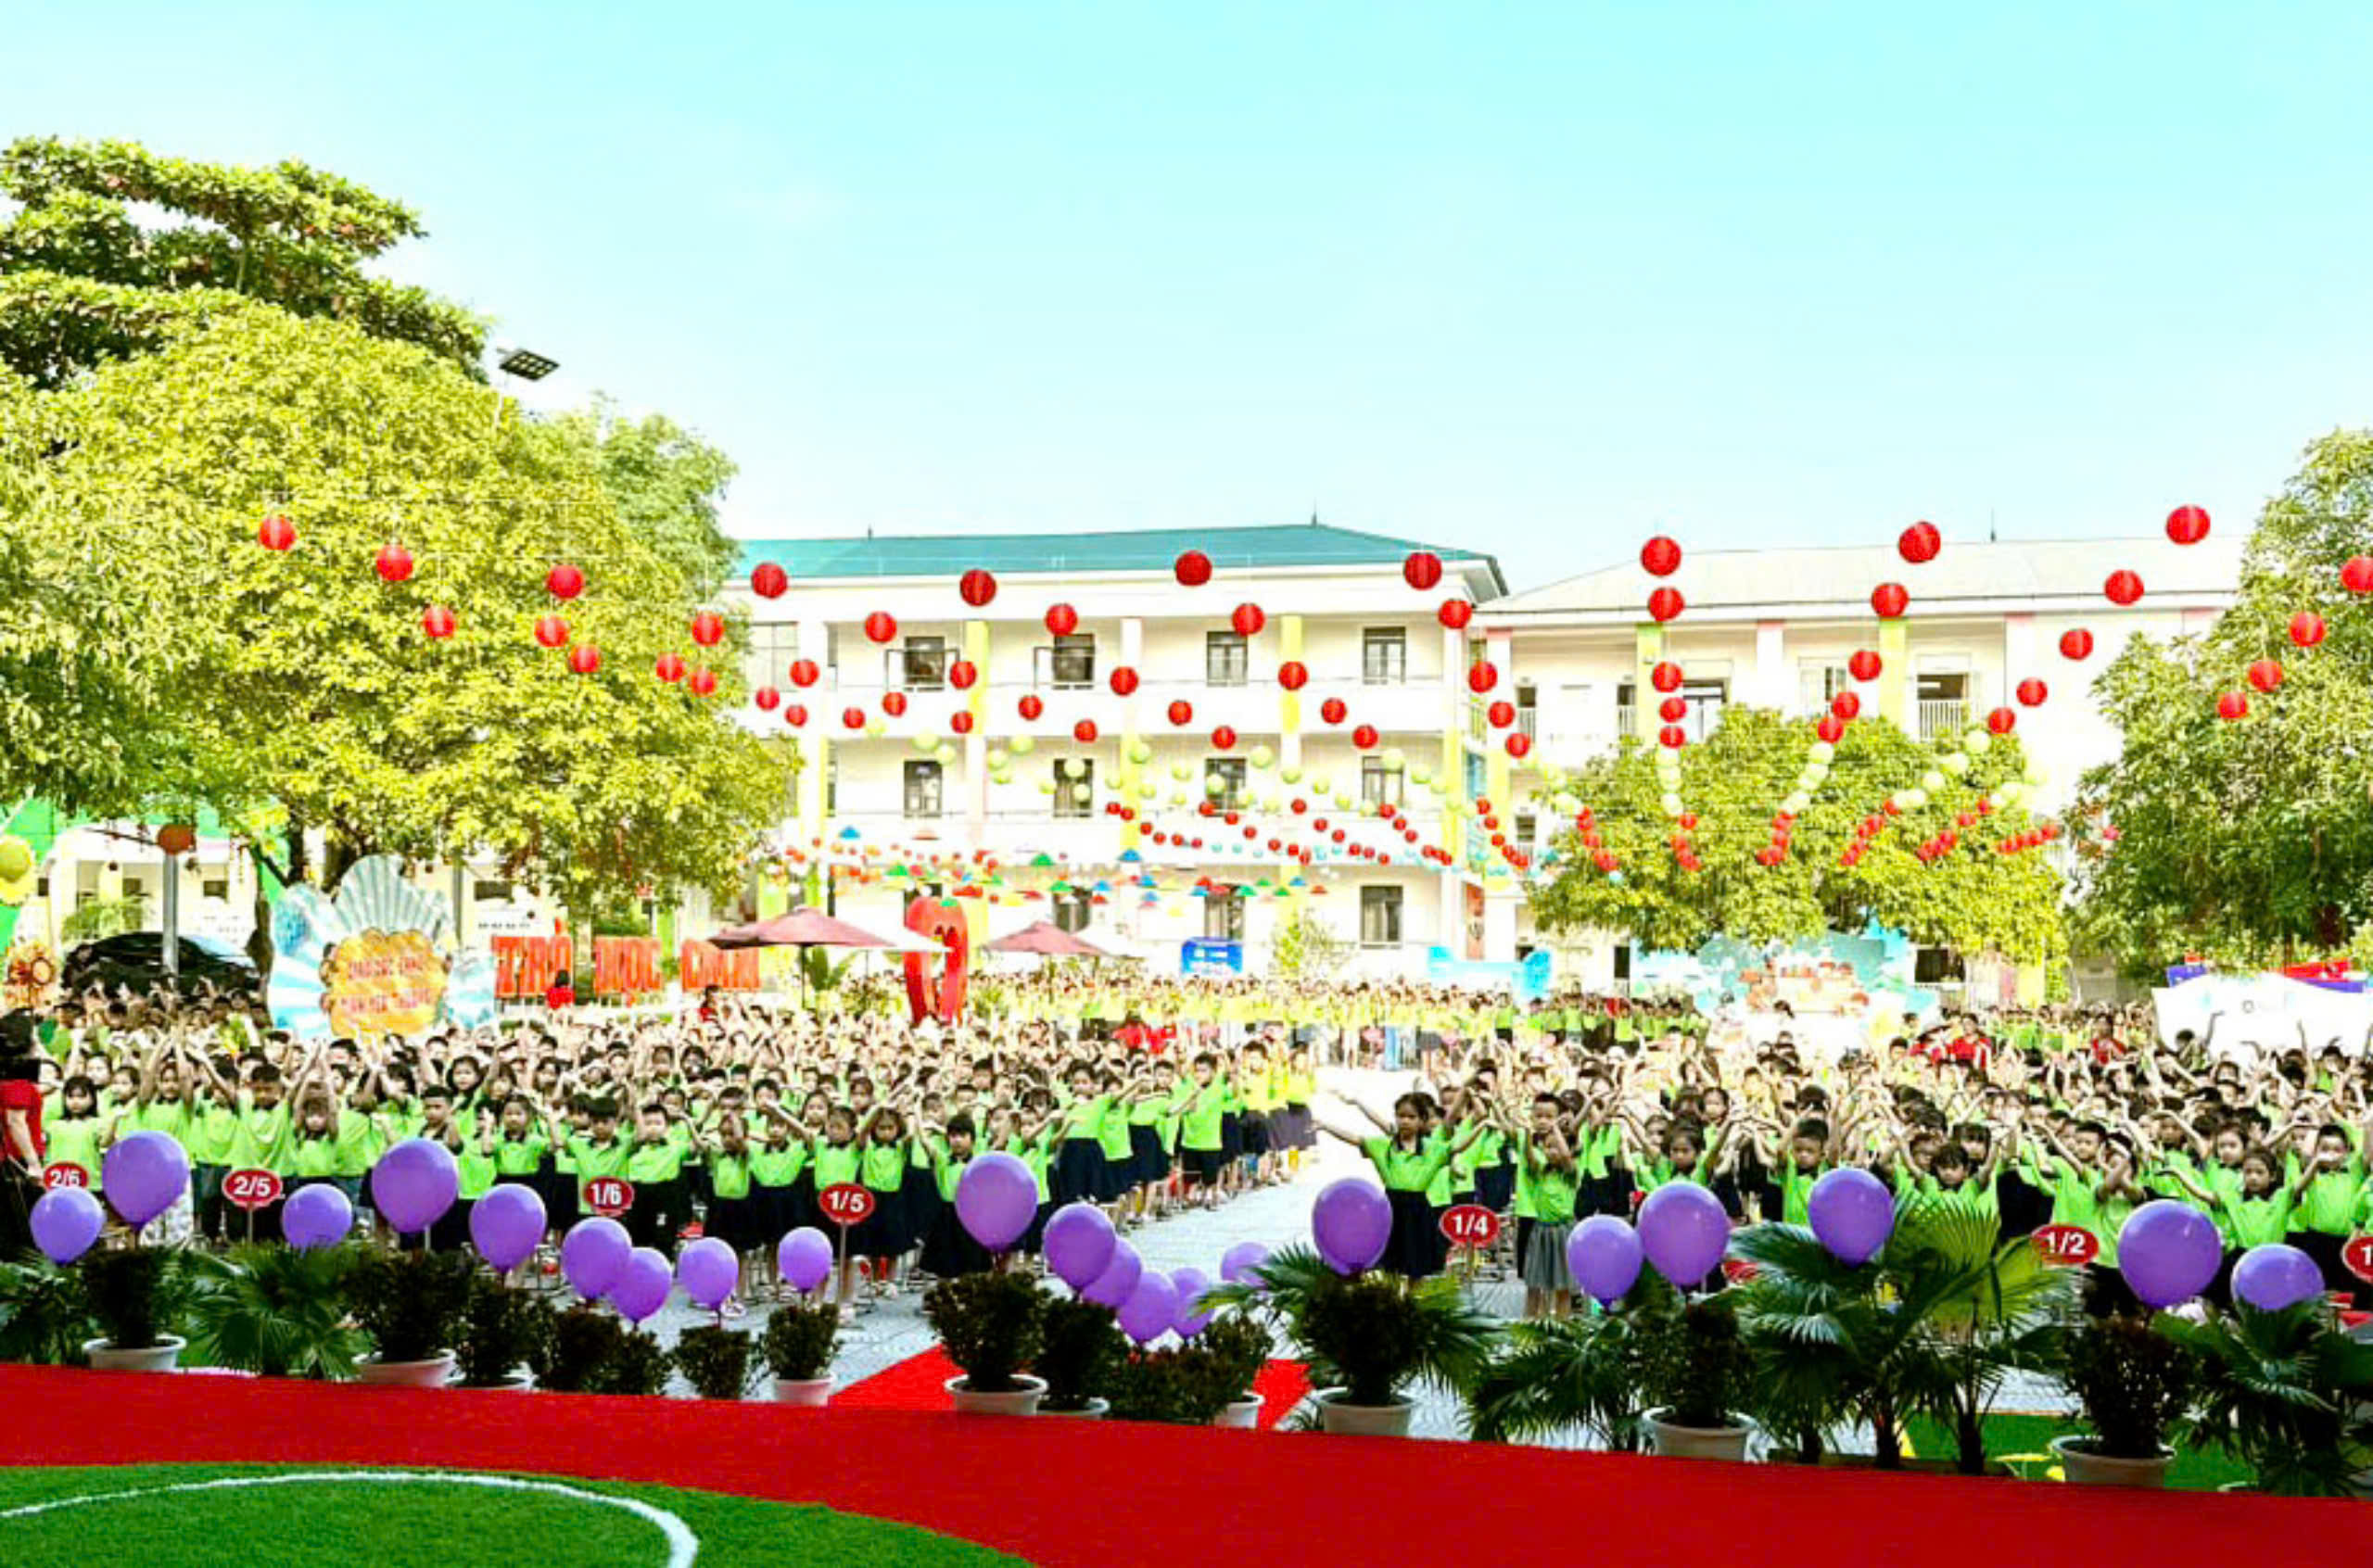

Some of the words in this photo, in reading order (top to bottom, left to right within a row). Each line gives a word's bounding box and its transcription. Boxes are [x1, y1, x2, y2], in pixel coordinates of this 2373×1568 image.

[234, 1175, 271, 1196] 2/5
[590, 1182, 622, 1205] 1/6
[827, 1190, 865, 1212] 1/5
[1453, 1213, 1488, 1236] 1/4
[2046, 1232, 2087, 1255] 1/2
